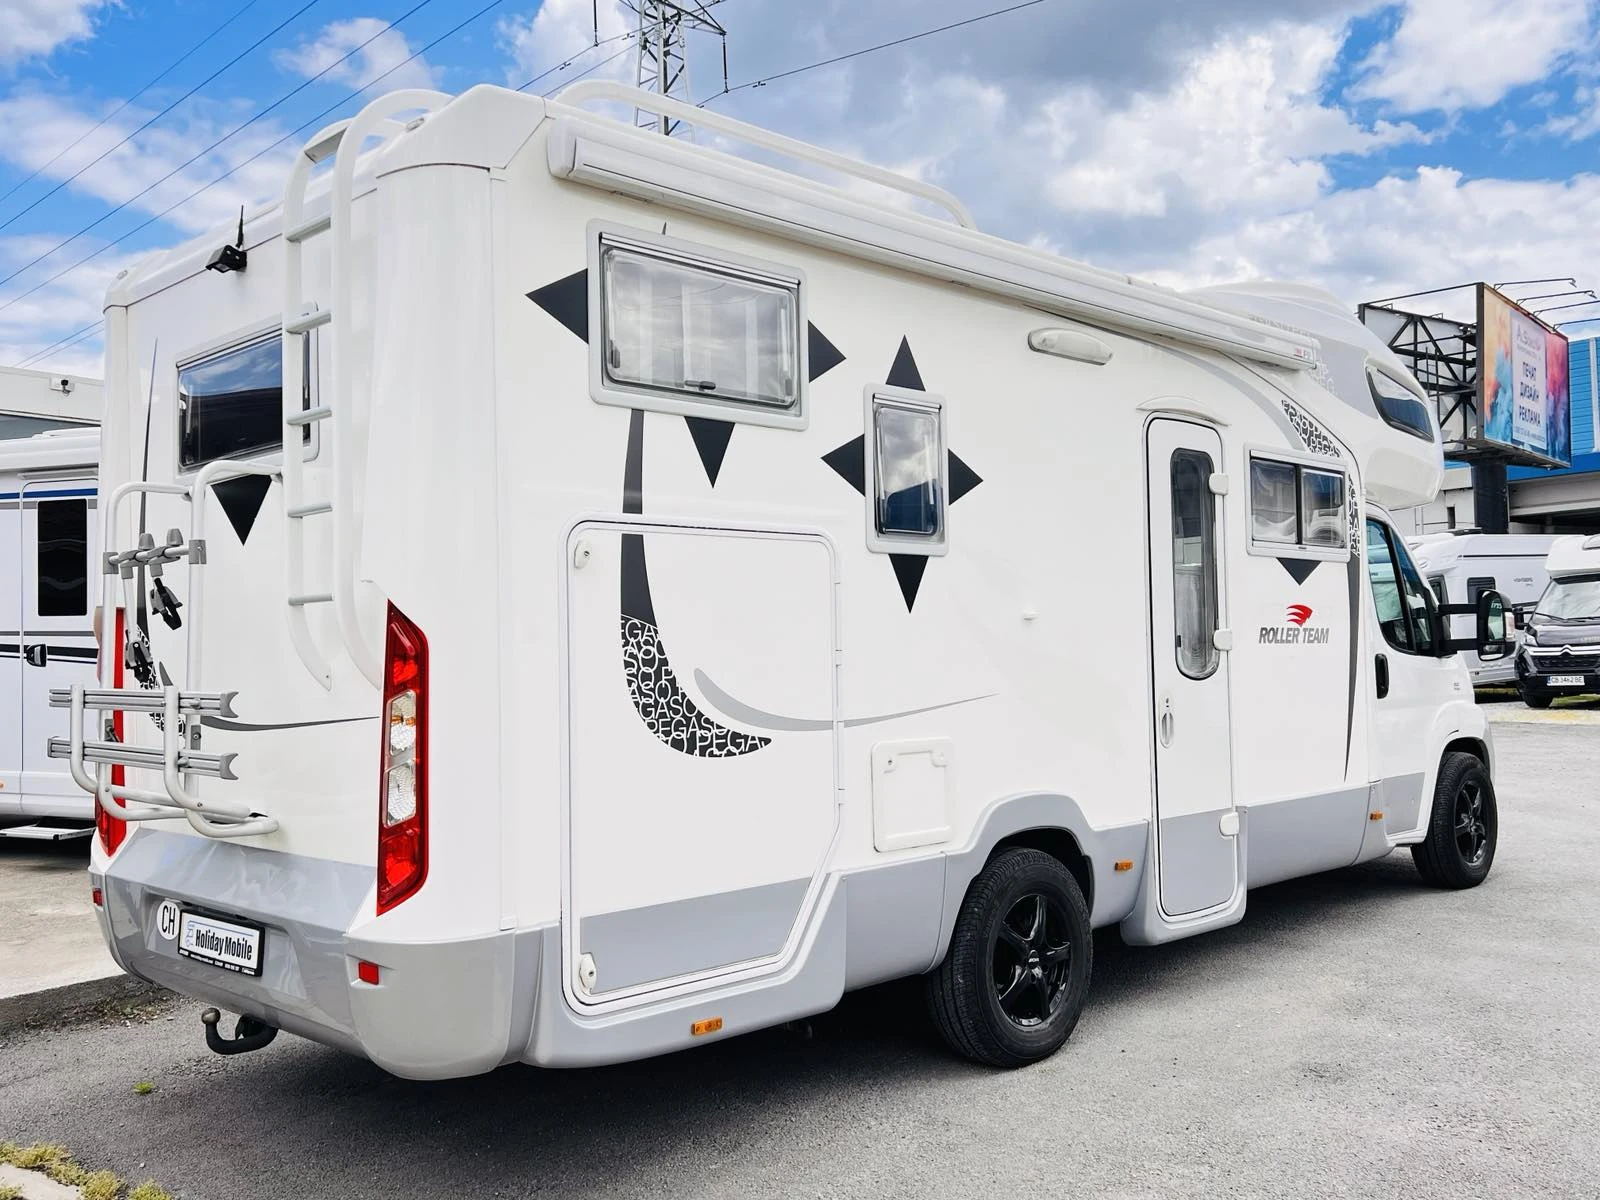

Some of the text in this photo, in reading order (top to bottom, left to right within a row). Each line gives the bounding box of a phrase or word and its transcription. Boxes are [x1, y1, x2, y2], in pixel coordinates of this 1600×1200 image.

[1522, 361, 1536, 380] ПЕЧАТ
[1520, 381, 1540, 402] ДИЗАЙН
[1518, 404, 1541, 427] РЕКЛАМА
[1259, 626, 1330, 644] ROLLER TEAM
[162, 905, 176, 936] CH
[195, 929, 224, 956] Holiday
[224, 936, 253, 961] Mobile
